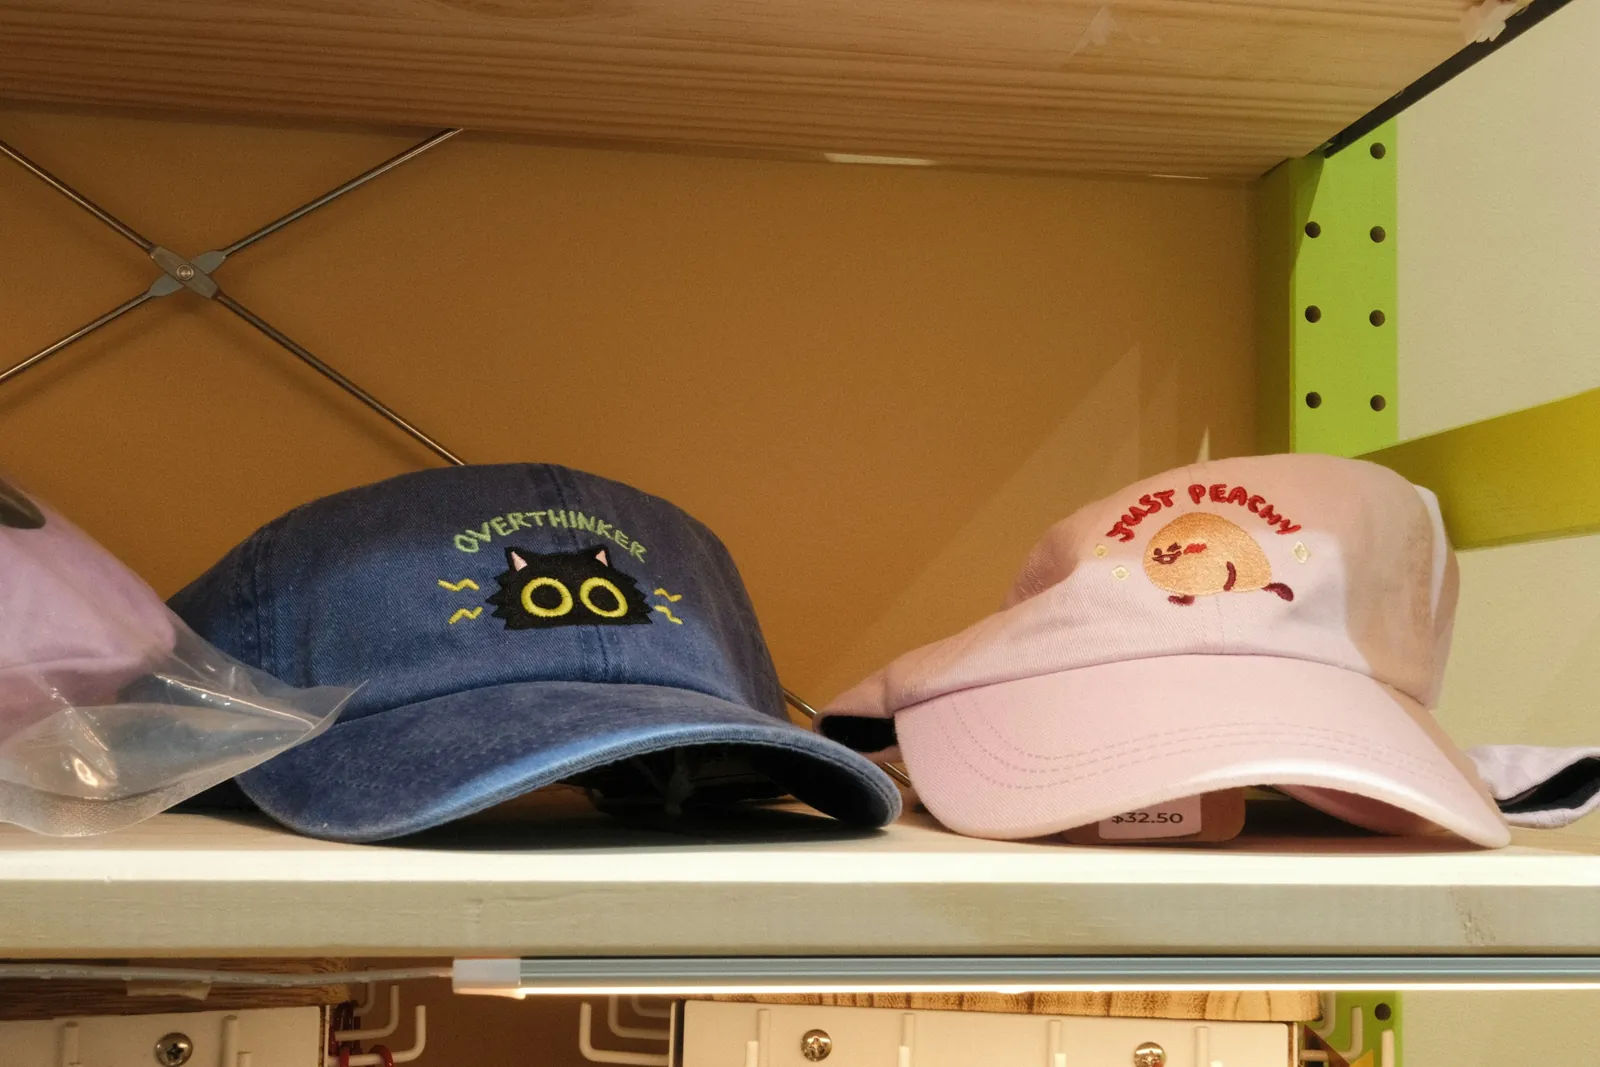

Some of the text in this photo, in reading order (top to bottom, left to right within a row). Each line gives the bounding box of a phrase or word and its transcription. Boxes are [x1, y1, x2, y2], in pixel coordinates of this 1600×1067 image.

[453, 509, 648, 563] OVERTHINKER
[1106, 483, 1302, 543] JUST PEACHY
[1111, 812, 1184, 825] $32.50
